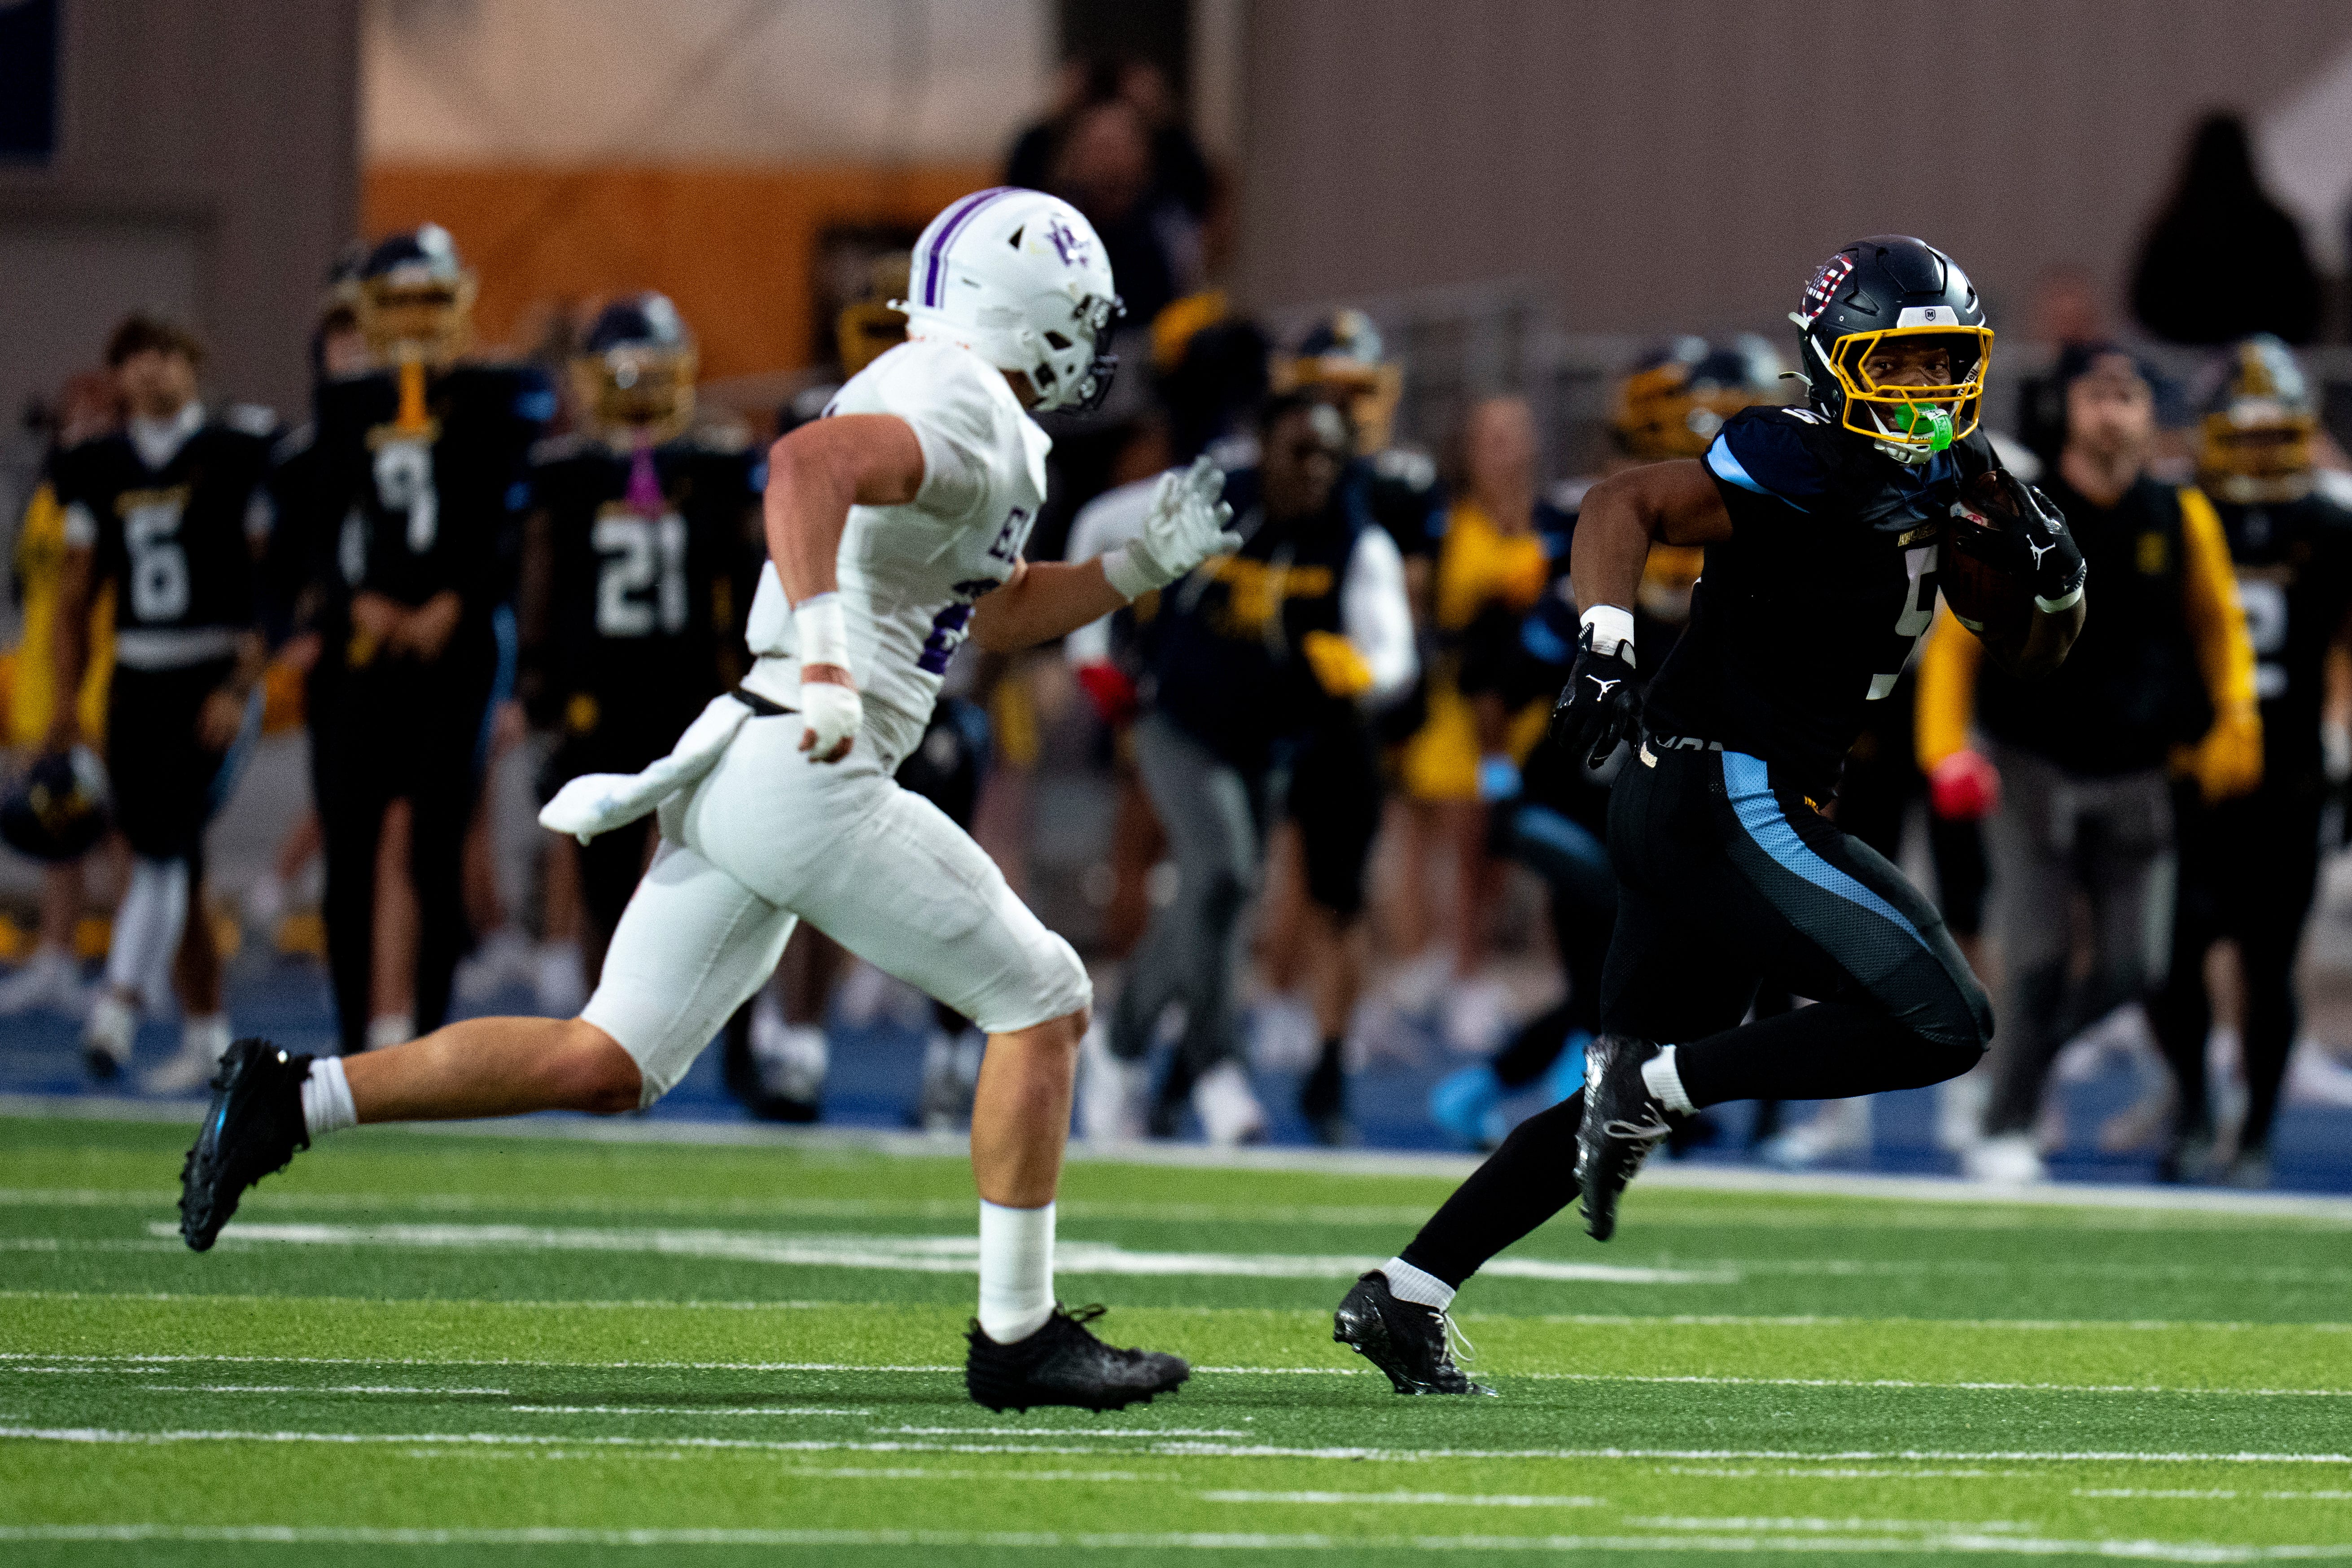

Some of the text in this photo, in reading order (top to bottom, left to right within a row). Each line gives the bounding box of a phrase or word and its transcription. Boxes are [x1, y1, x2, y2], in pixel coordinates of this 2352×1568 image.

[372, 439, 440, 555] 9
[124, 500, 192, 622] 6
[591, 512, 690, 638] 21
